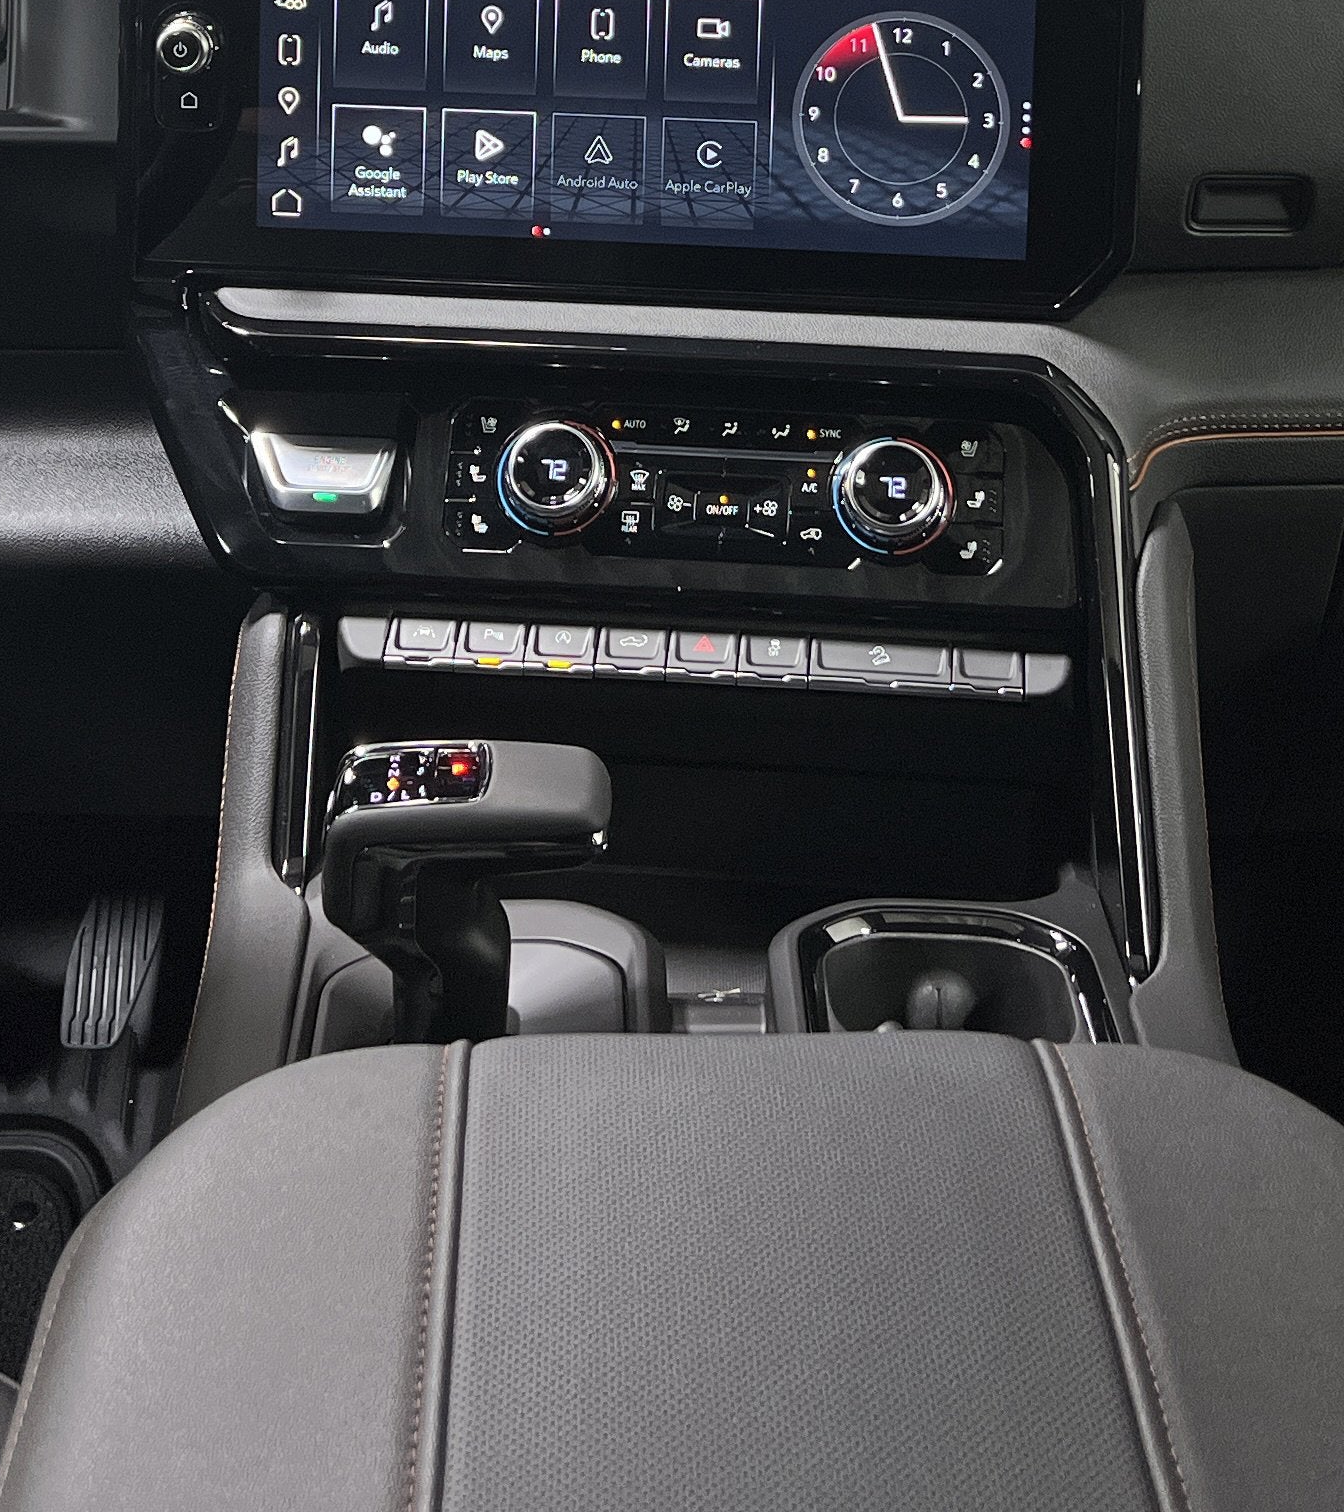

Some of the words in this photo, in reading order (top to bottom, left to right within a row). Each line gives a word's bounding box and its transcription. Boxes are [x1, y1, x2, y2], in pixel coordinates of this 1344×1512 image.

[893, 27, 913, 44] 12
[361, 40, 400, 55] Audio
[472, 45, 509, 61] Maps
[850, 38, 867, 53] 11
[942, 41, 950, 56] 1
[580, 49, 622, 65] Phone
[683, 53, 741, 70] Cameras
[816, 66, 836, 82] 10
[972, 72, 984, 88] 2
[808, 106, 821, 122] 9
[983, 113, 995, 129] 3
[817, 147, 830, 163] 8
[967, 154, 980, 169] 4
[354, 166, 401, 183] Google
[456, 169, 484, 186] Play
[486, 171, 519, 185] Store
[557, 174, 606, 190] Android
[609, 176, 639, 190] Auto
[347, 184, 407, 199] Assistant
[664, 178, 701, 195] Apple
[704, 180, 753, 197] CarPlay
[848, 179, 860, 194] 7
[936, 183, 948, 199] 5
[892, 193, 904, 208] 6
[623, 419, 646, 430] AUTO
[819, 428, 842, 439] SYNC
[540, 458, 567, 480] 72
[801, 482, 818, 493] A/C
[879, 475, 907, 499] 72
[706, 504, 739, 516] ON/OFF
